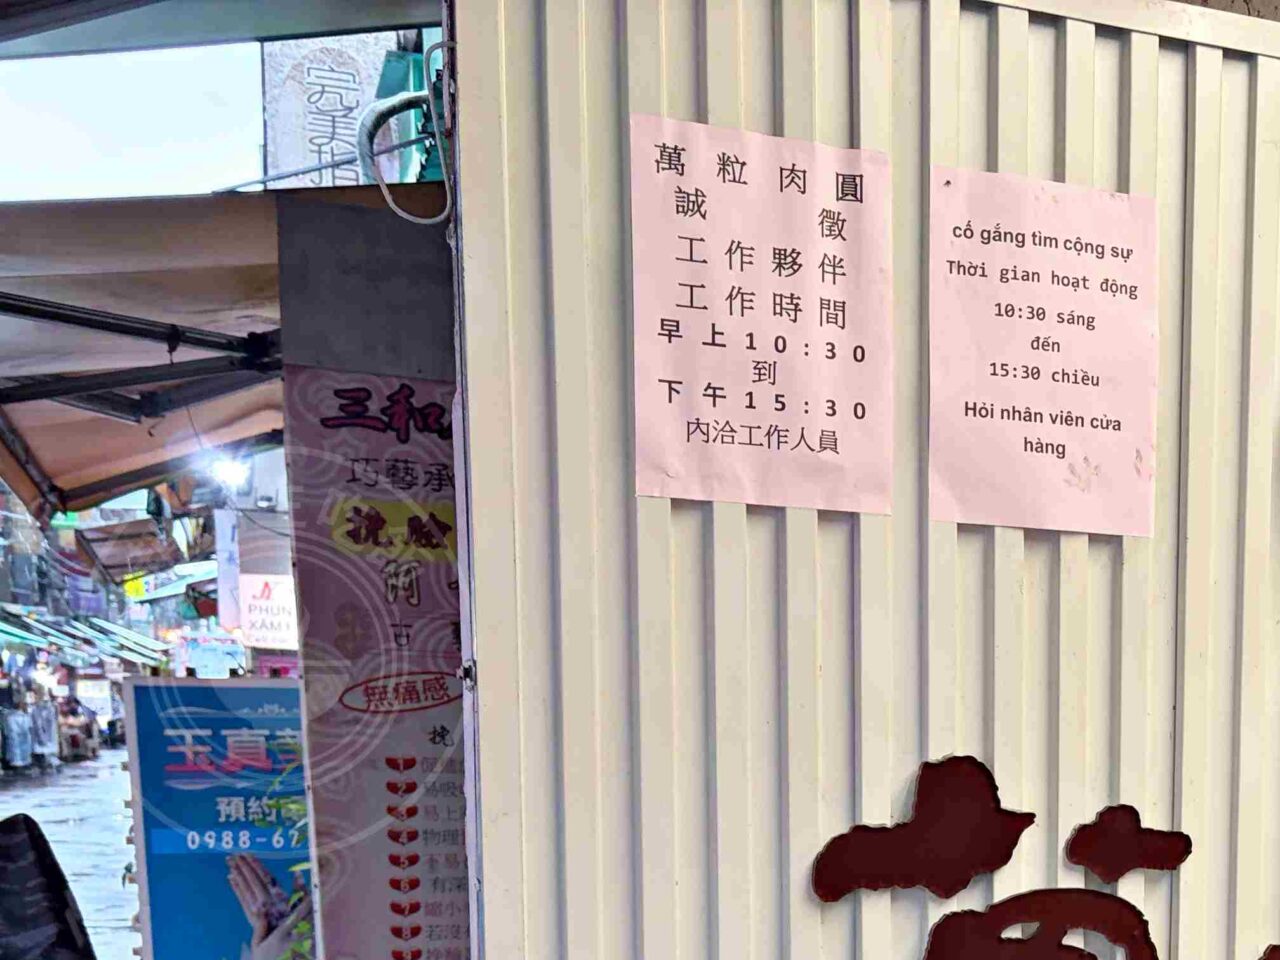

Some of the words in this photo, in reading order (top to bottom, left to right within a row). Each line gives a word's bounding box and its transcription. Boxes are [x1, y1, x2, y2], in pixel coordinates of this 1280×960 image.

[654, 143, 864, 204] 萬粒肉圓
[952, 219, 975, 241] cố
[980, 223, 1026, 249] gắng
[1031, 230, 1059, 250] tìm
[1063, 236, 1106, 260] cộng
[1110, 244, 1134, 261] sự
[674, 234, 846, 286] 工作夥伴
[946, 259, 989, 278] Thời
[999, 264, 1041, 285] gian
[1050, 270, 1091, 291] hoạt
[1099, 277, 1139, 300] động
[674, 282, 846, 330] 工作時間
[993, 302, 1047, 321] 10:30
[1055, 309, 1096, 331] sáng
[1030, 335, 1061, 353] đến
[751, 360, 777, 386] 到
[989, 362, 1041, 381] 15:30
[1050, 367, 1100, 387] chiều
[320, 383, 453, 443] 三和
[963, 401, 995, 419] Hỏi
[999, 405, 1044, 425] nhân
[1049, 409, 1085, 429] viên
[1089, 413, 1122, 432] cửa
[1023, 436, 1066, 460] hàng
[345, 457, 455, 493] 巧藝承
[363, 674, 450, 710] 無痛感
